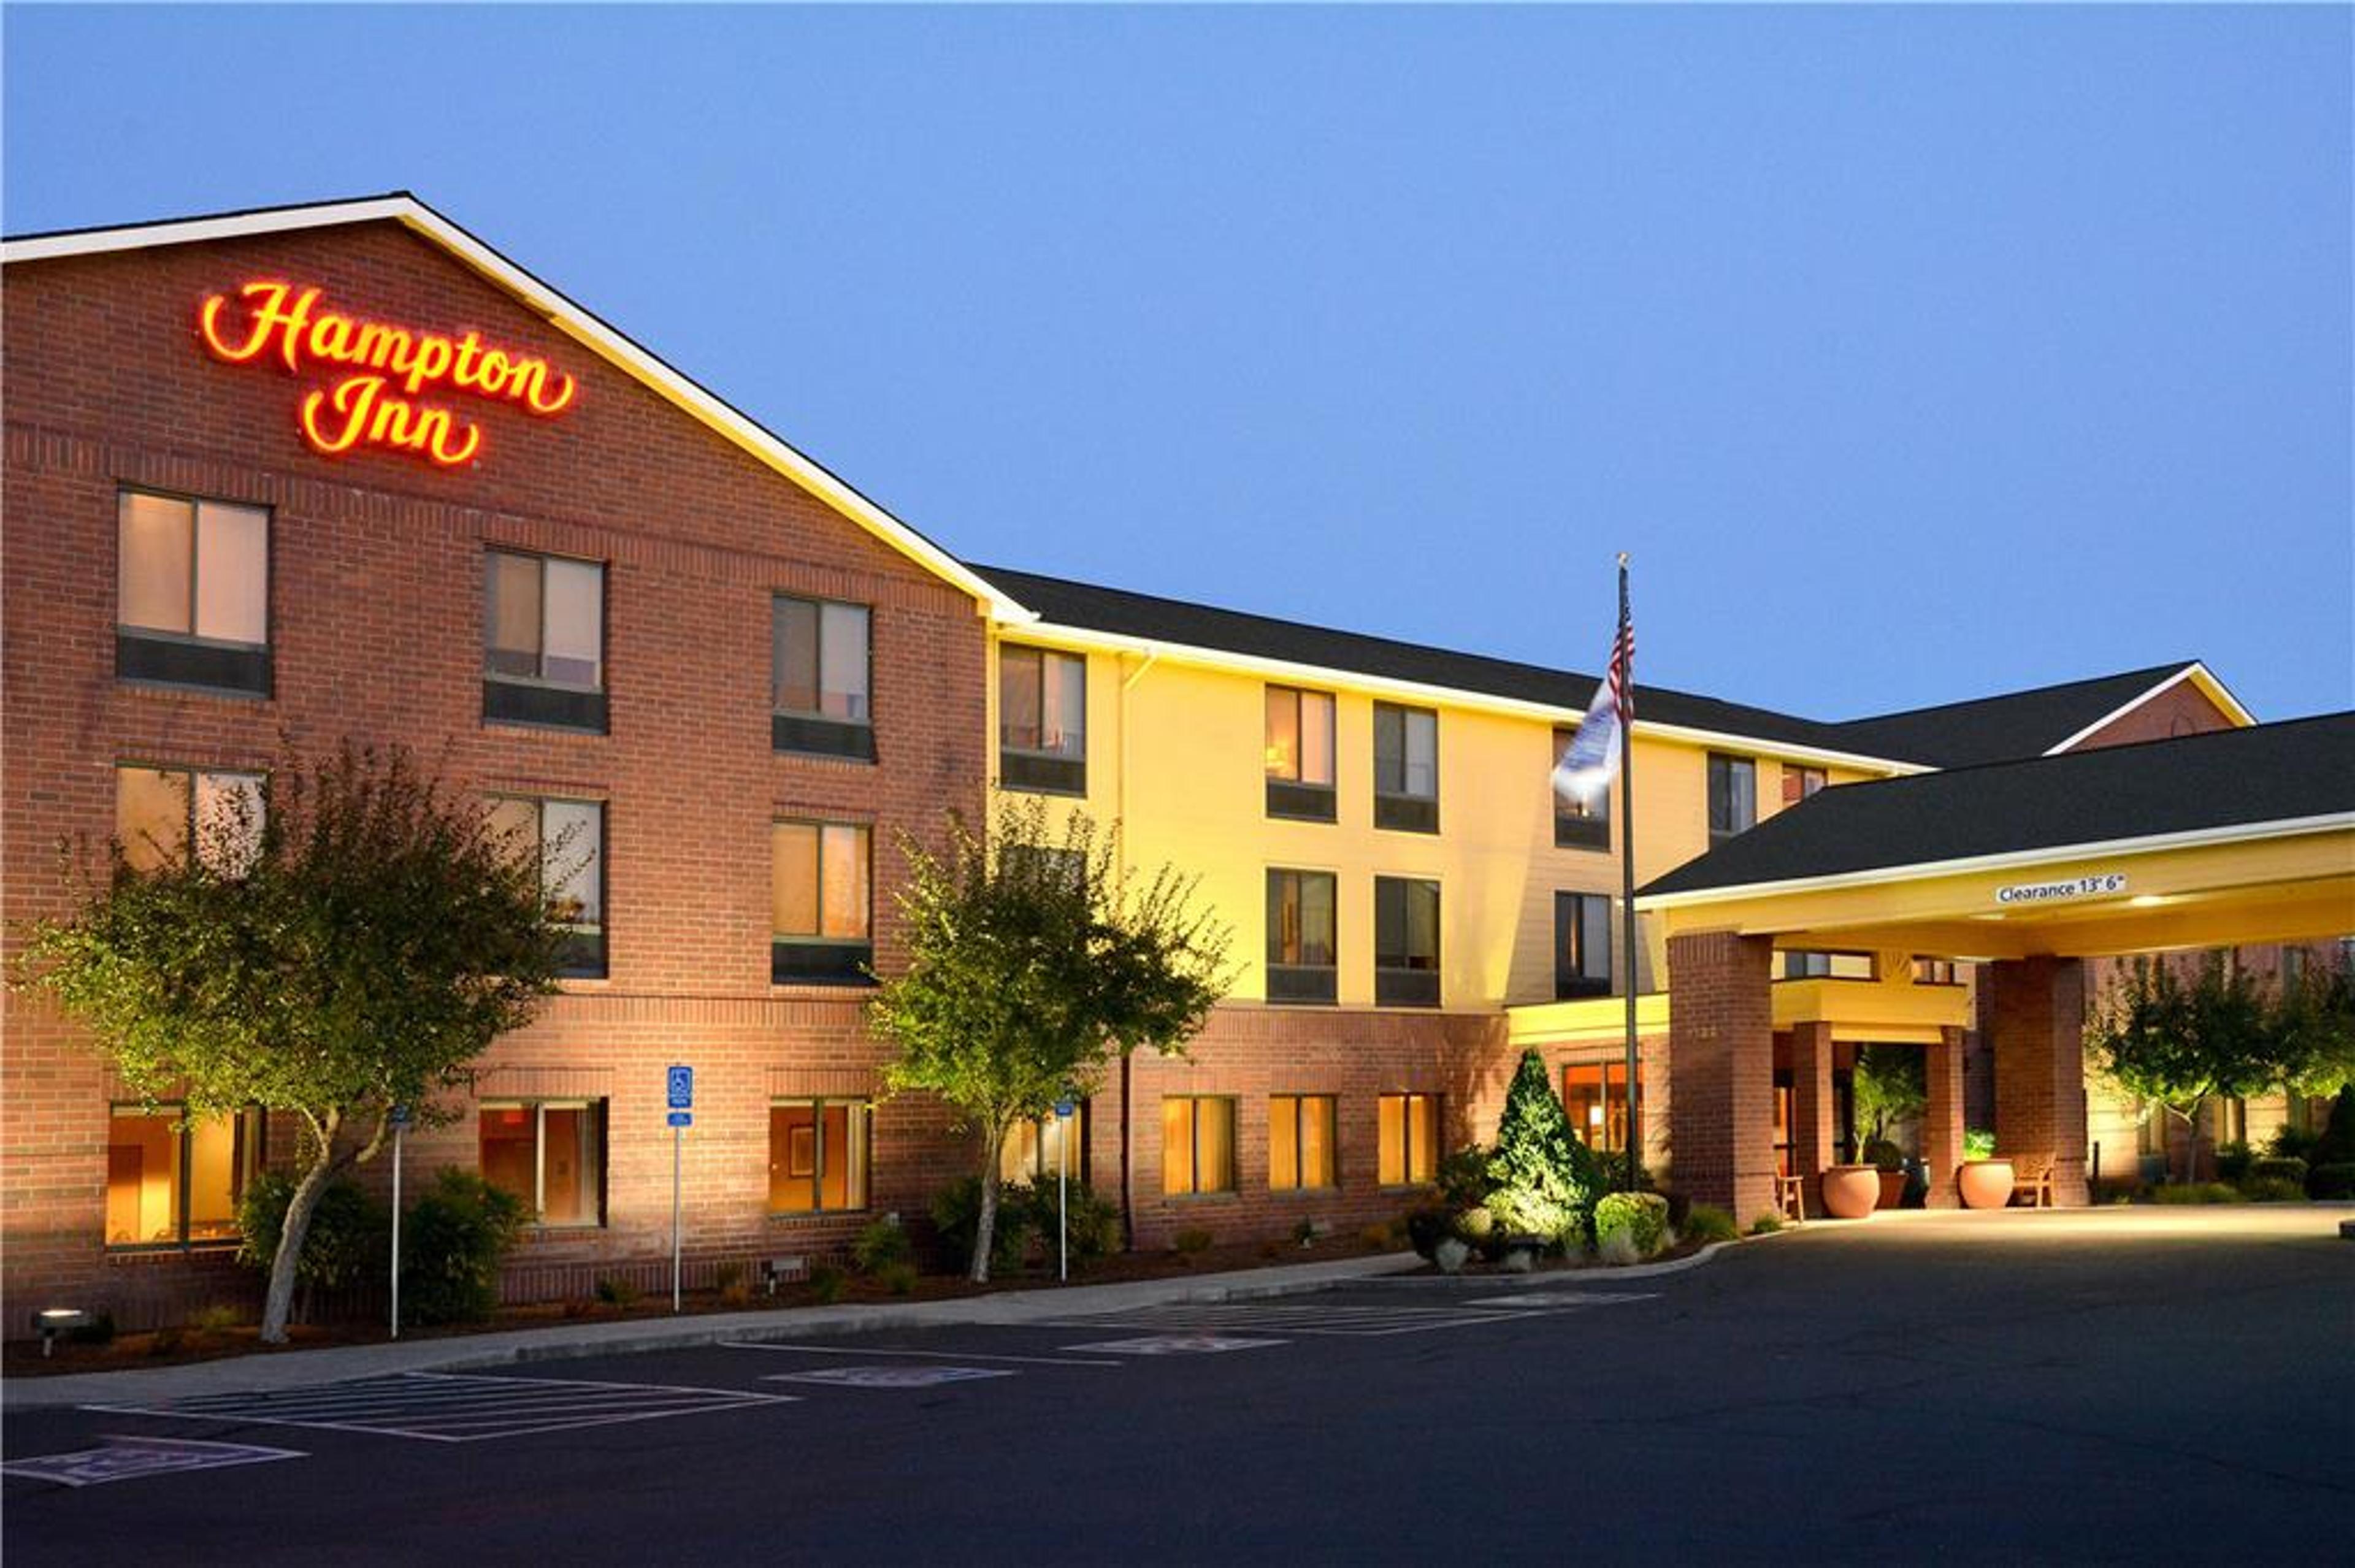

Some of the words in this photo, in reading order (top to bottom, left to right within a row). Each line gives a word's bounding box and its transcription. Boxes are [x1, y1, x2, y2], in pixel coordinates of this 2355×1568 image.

[202, 281, 575, 412] Hampton
[303, 377, 479, 464] Inn
[1999, 883, 2075, 902] Clearance
